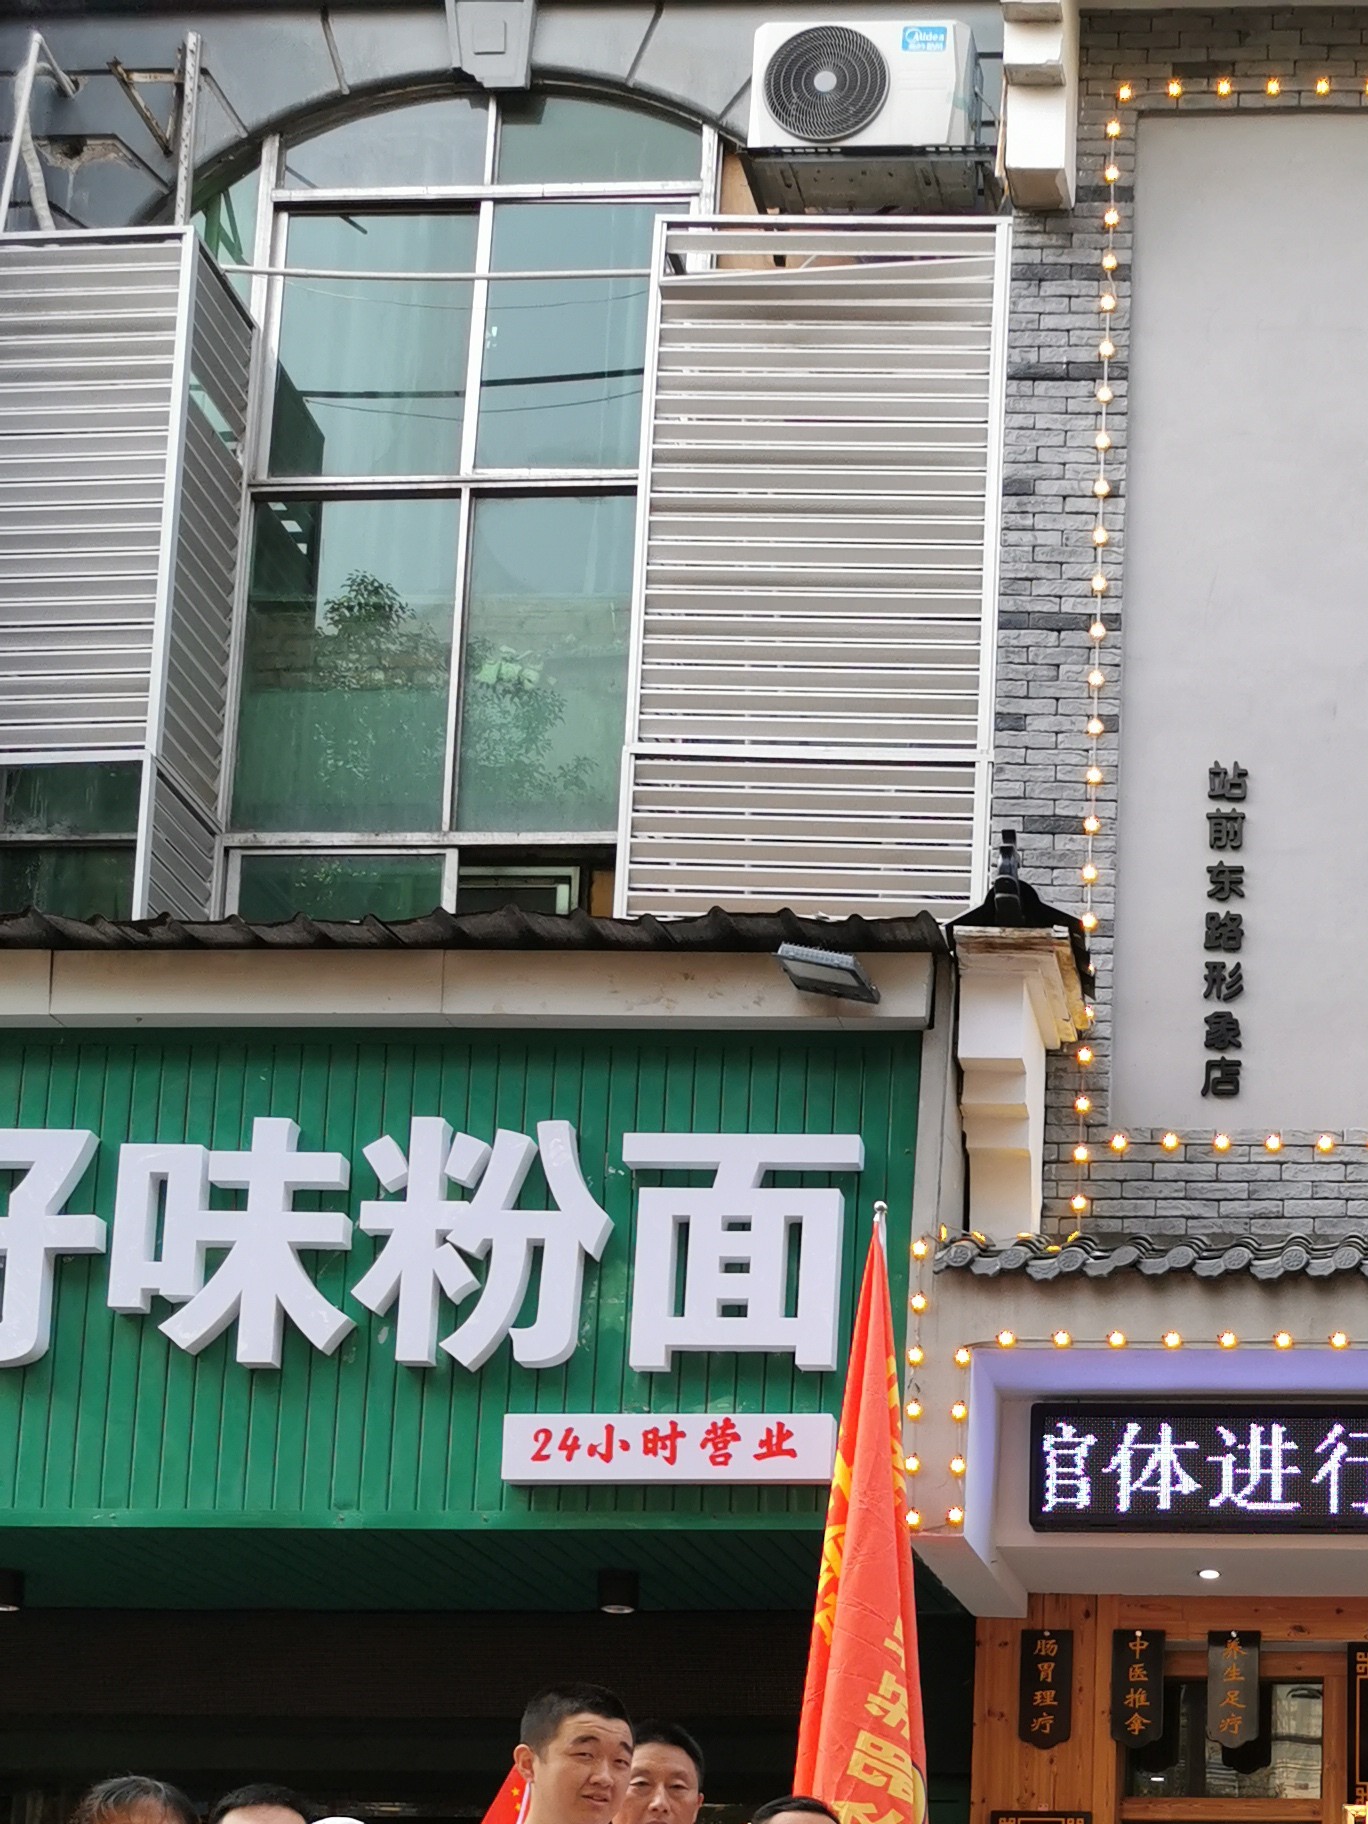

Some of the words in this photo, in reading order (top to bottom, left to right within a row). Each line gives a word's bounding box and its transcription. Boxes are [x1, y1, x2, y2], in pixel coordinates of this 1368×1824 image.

[1200, 760, 1249, 1098] 站前东路形象店
[530, 1417, 798, 1467] 24小时营业
[1031, 1638, 1059, 1734] 肠胃理疗
[1219, 1637, 1248, 1735] 养生足疗
